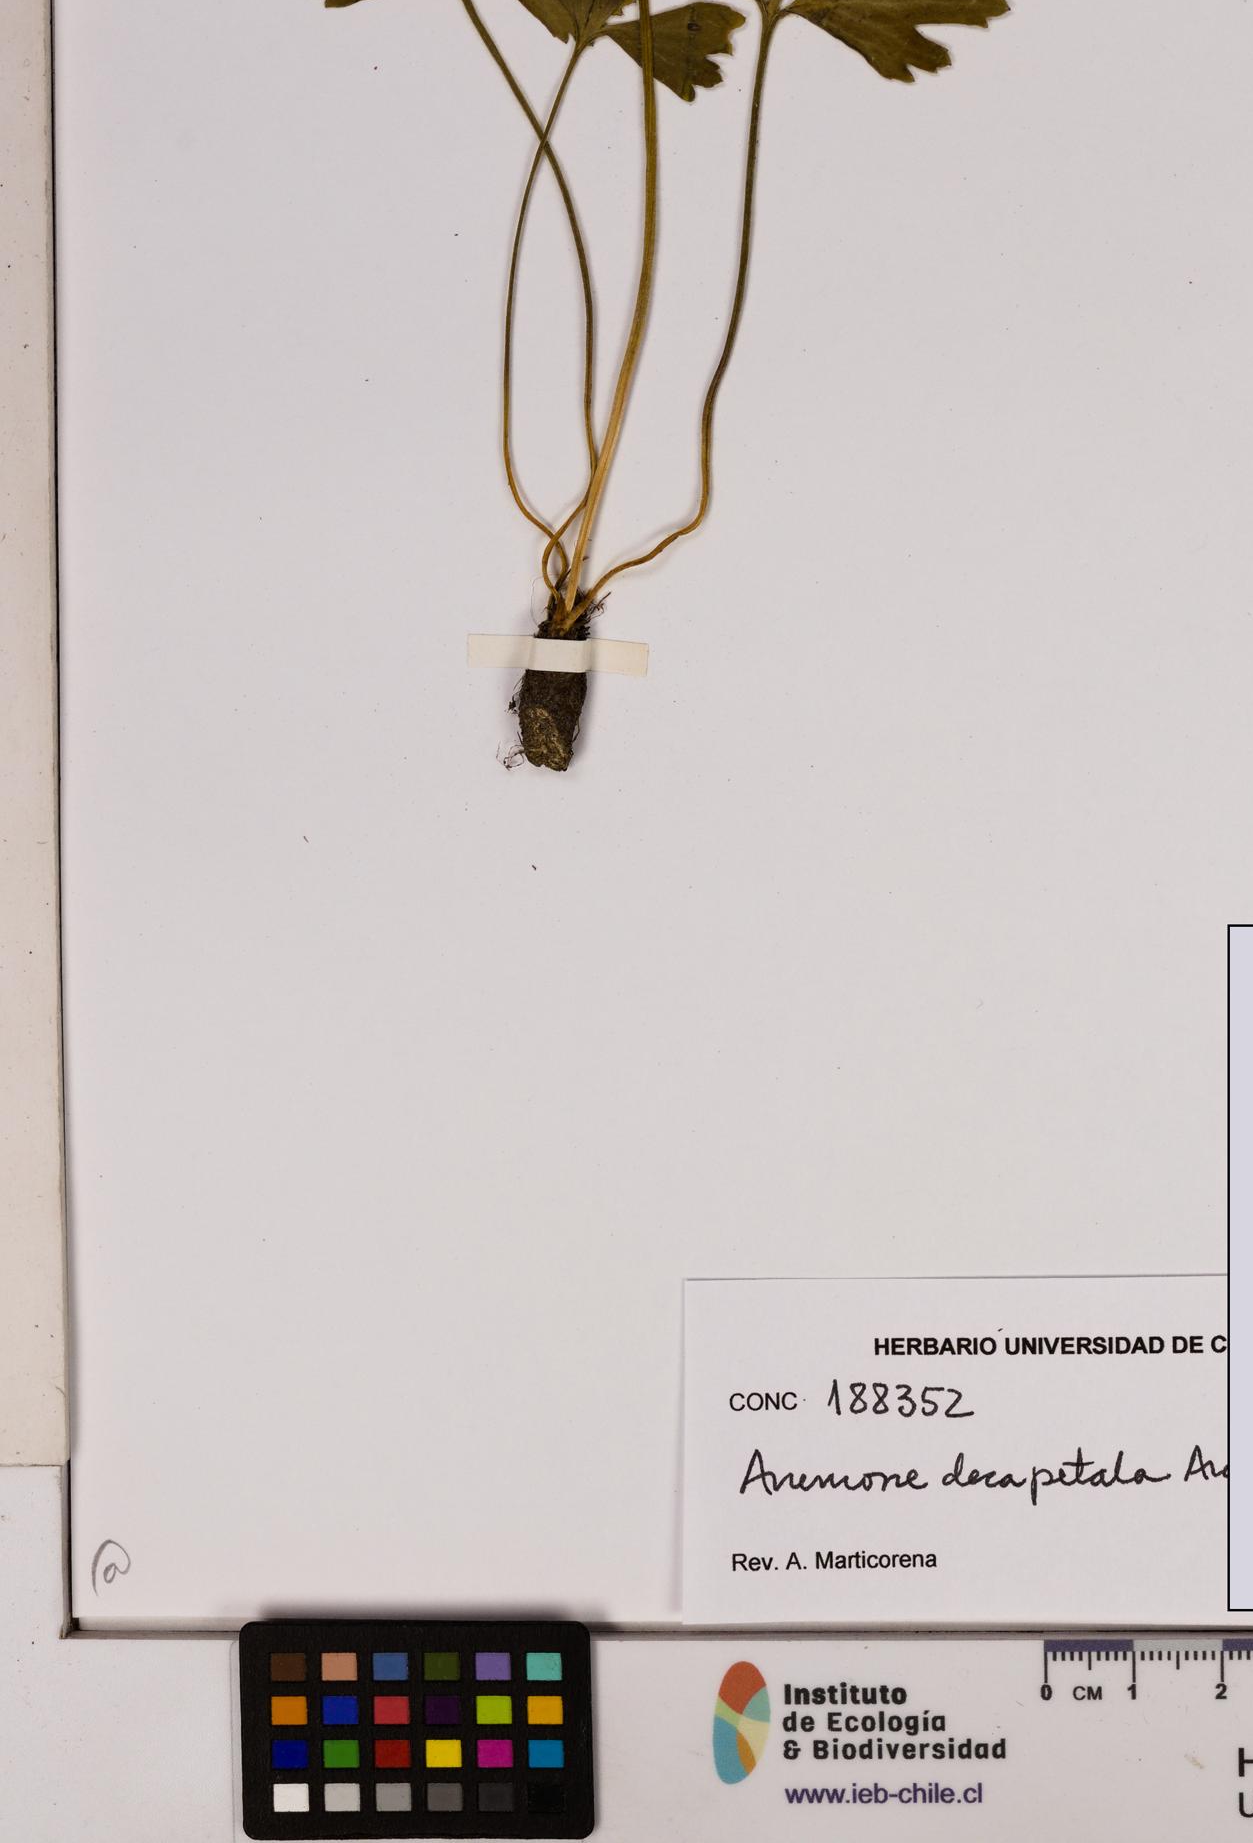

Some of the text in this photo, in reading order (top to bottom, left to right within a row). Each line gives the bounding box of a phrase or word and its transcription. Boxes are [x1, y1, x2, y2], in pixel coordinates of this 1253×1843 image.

[875, 1337, 996, 1355] HERBARIO
[1005, 1336, 1164, 1355] UNIVERSIDAD
[1172, 1336, 1203, 1353] DE
[730, 1392, 797, 1411] CONC
[828, 1379, 974, 1418] 188352
[740, 1449, 928, 1495] Anemone
[942, 1447, 1171, 1506] decapetala
[732, 1551, 936, 1571] Rev. A. Marticorena
[785, 1682, 907, 1705] Instituto
[1041, 1684, 1052, 1700] 0
[1073, 1686, 1102, 1700] CM
[1128, 1684, 1136, 1700] 1
[1216, 1683, 1227, 1699] 2
[783, 1710, 945, 1736] de Ecología
[784, 1738, 1006, 1760] & Biodiversidad
[785, 1783, 982, 1804] www.ieb-chile.cl
